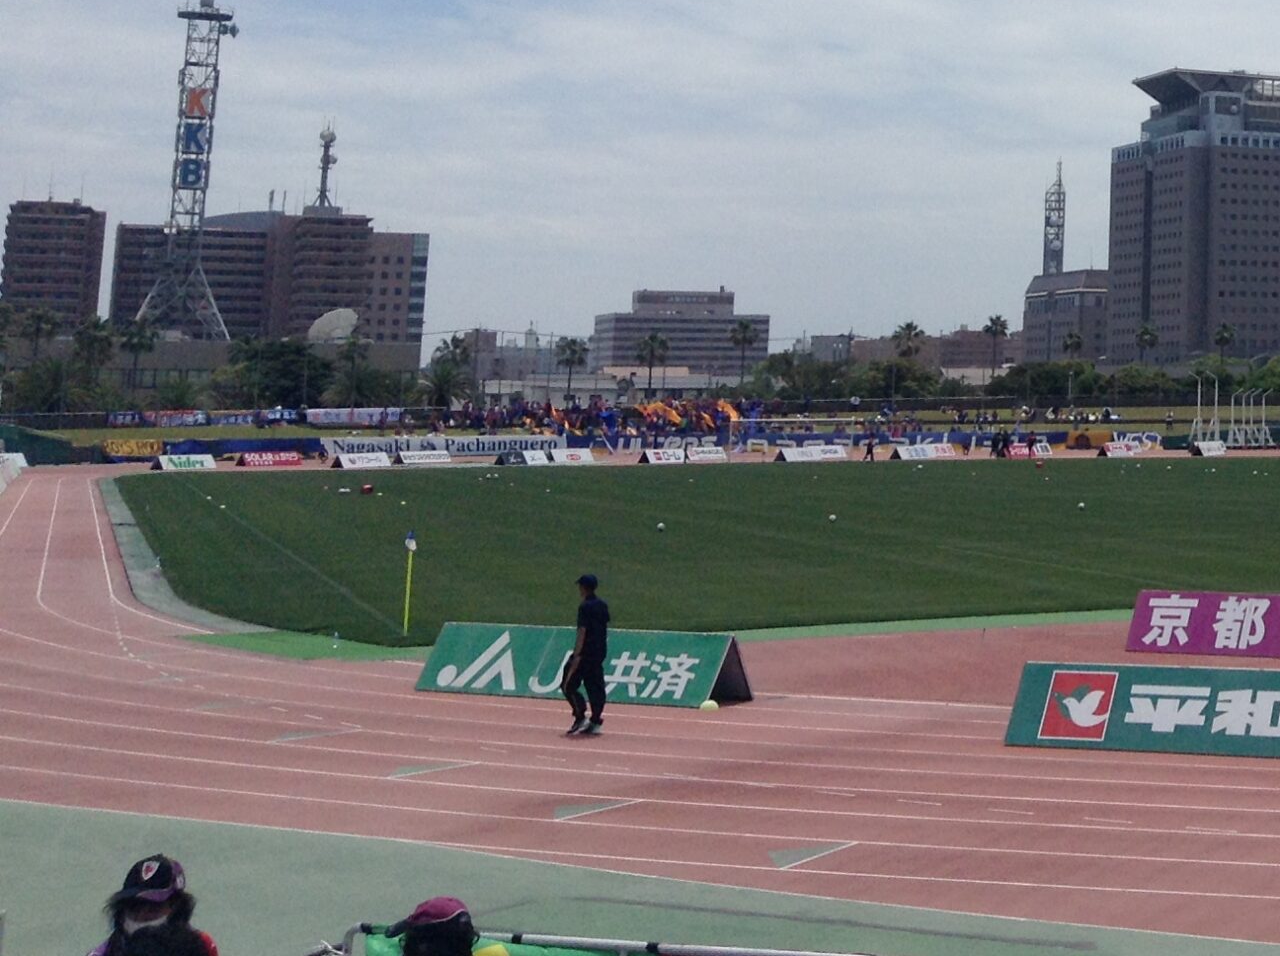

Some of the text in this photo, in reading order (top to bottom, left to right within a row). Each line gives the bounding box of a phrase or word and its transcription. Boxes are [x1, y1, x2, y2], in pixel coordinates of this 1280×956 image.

[181, 88, 209, 186] KKB
[332, 437, 558, 454] Nagasaki Pachanguero
